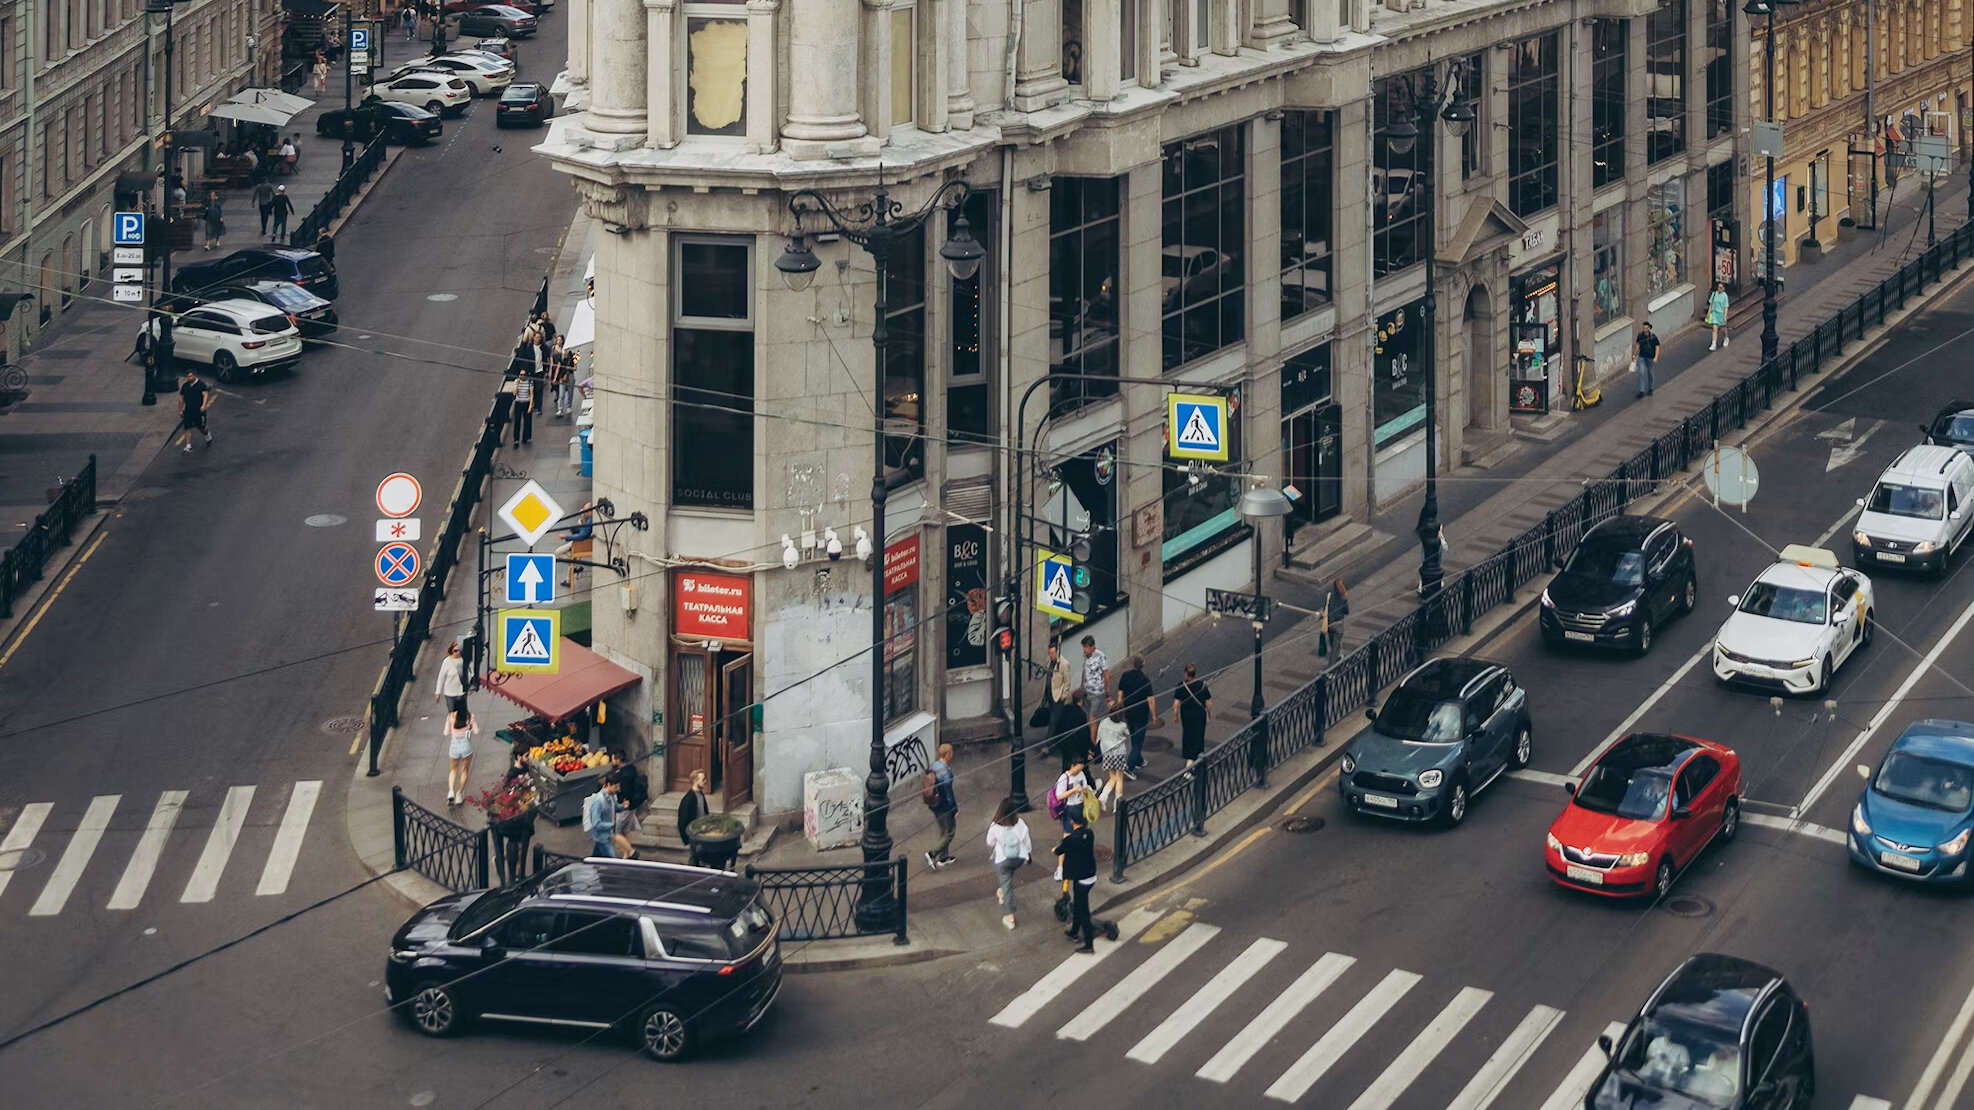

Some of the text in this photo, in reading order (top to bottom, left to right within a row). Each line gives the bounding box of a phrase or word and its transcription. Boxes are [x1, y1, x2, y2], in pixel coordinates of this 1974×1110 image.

[352, 31, 364, 48] P
[122, 215, 139, 240] P
[677, 488, 752, 501] SOCIAL CLUB
[953, 541, 978, 560] B&C
[891, 571, 908, 584] КАССА
[697, 583, 743, 597] bileter.ru
[683, 602, 743, 616] ТЕАТРАЛЬНАЯ
[698, 614, 728, 625] КАССА
